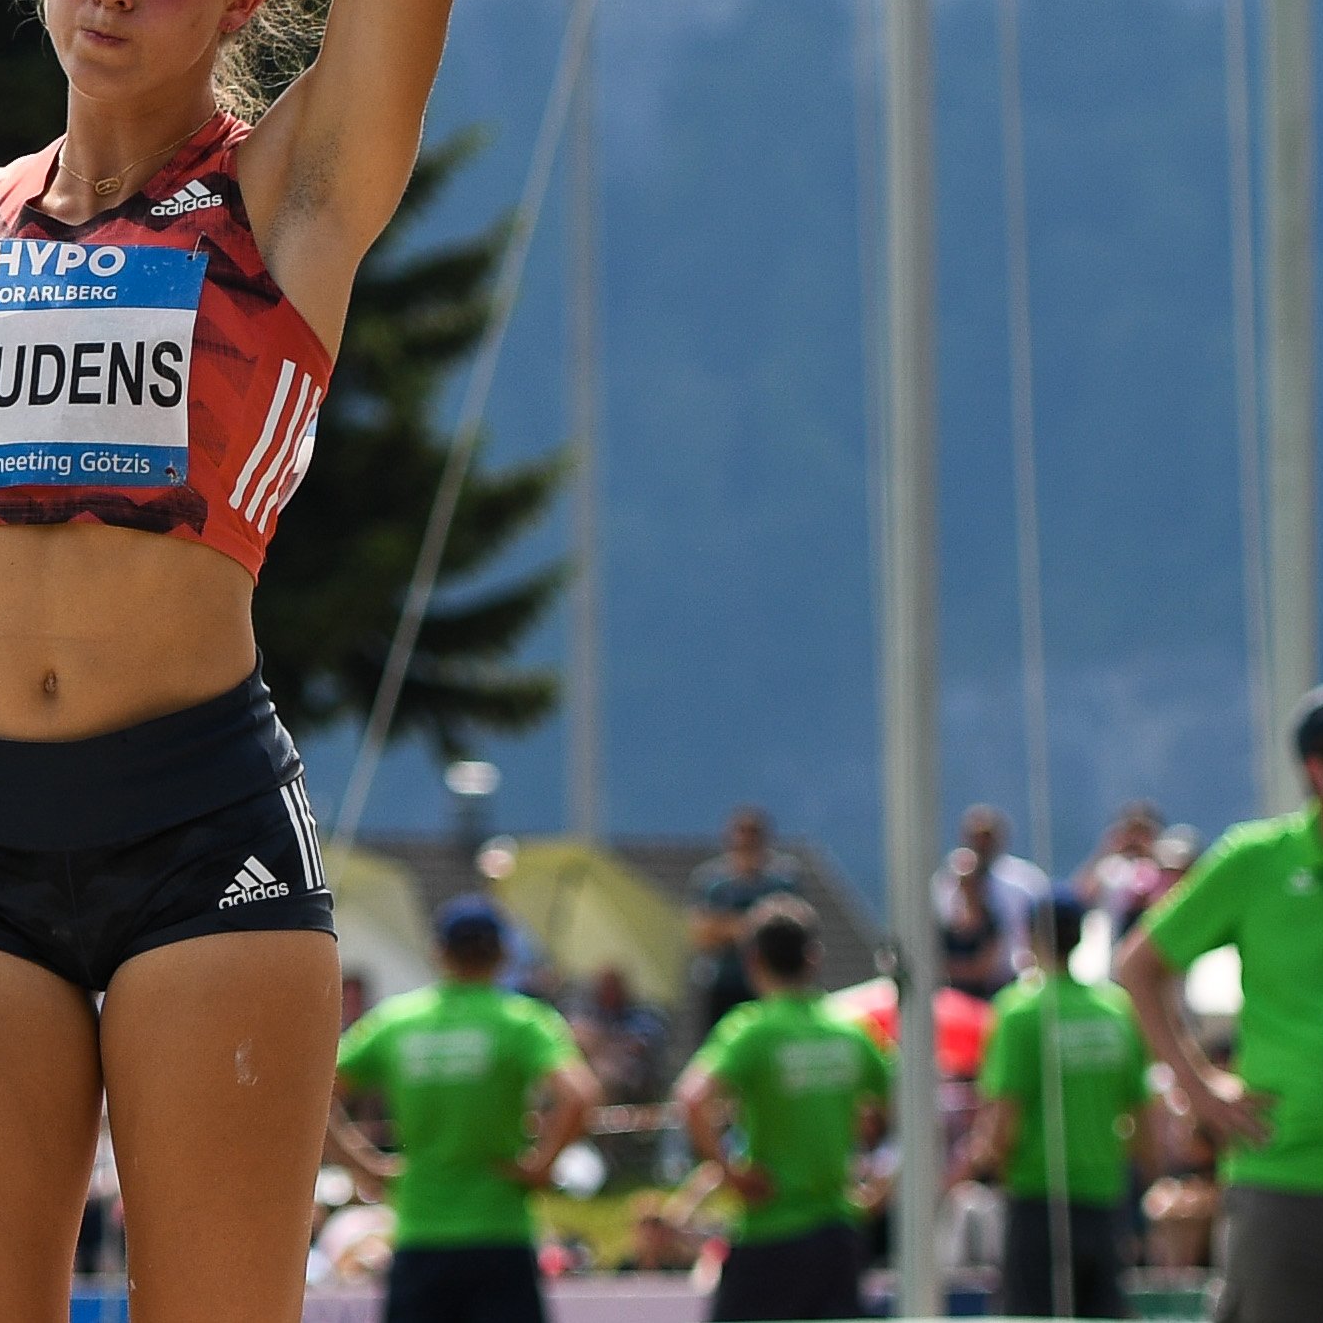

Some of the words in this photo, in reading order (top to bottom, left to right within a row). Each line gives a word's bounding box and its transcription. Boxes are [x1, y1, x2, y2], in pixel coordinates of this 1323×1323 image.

[151, 194, 223, 216] adidas
[80, 452, 151, 474] Götzis
[218, 882, 290, 910] adidas
